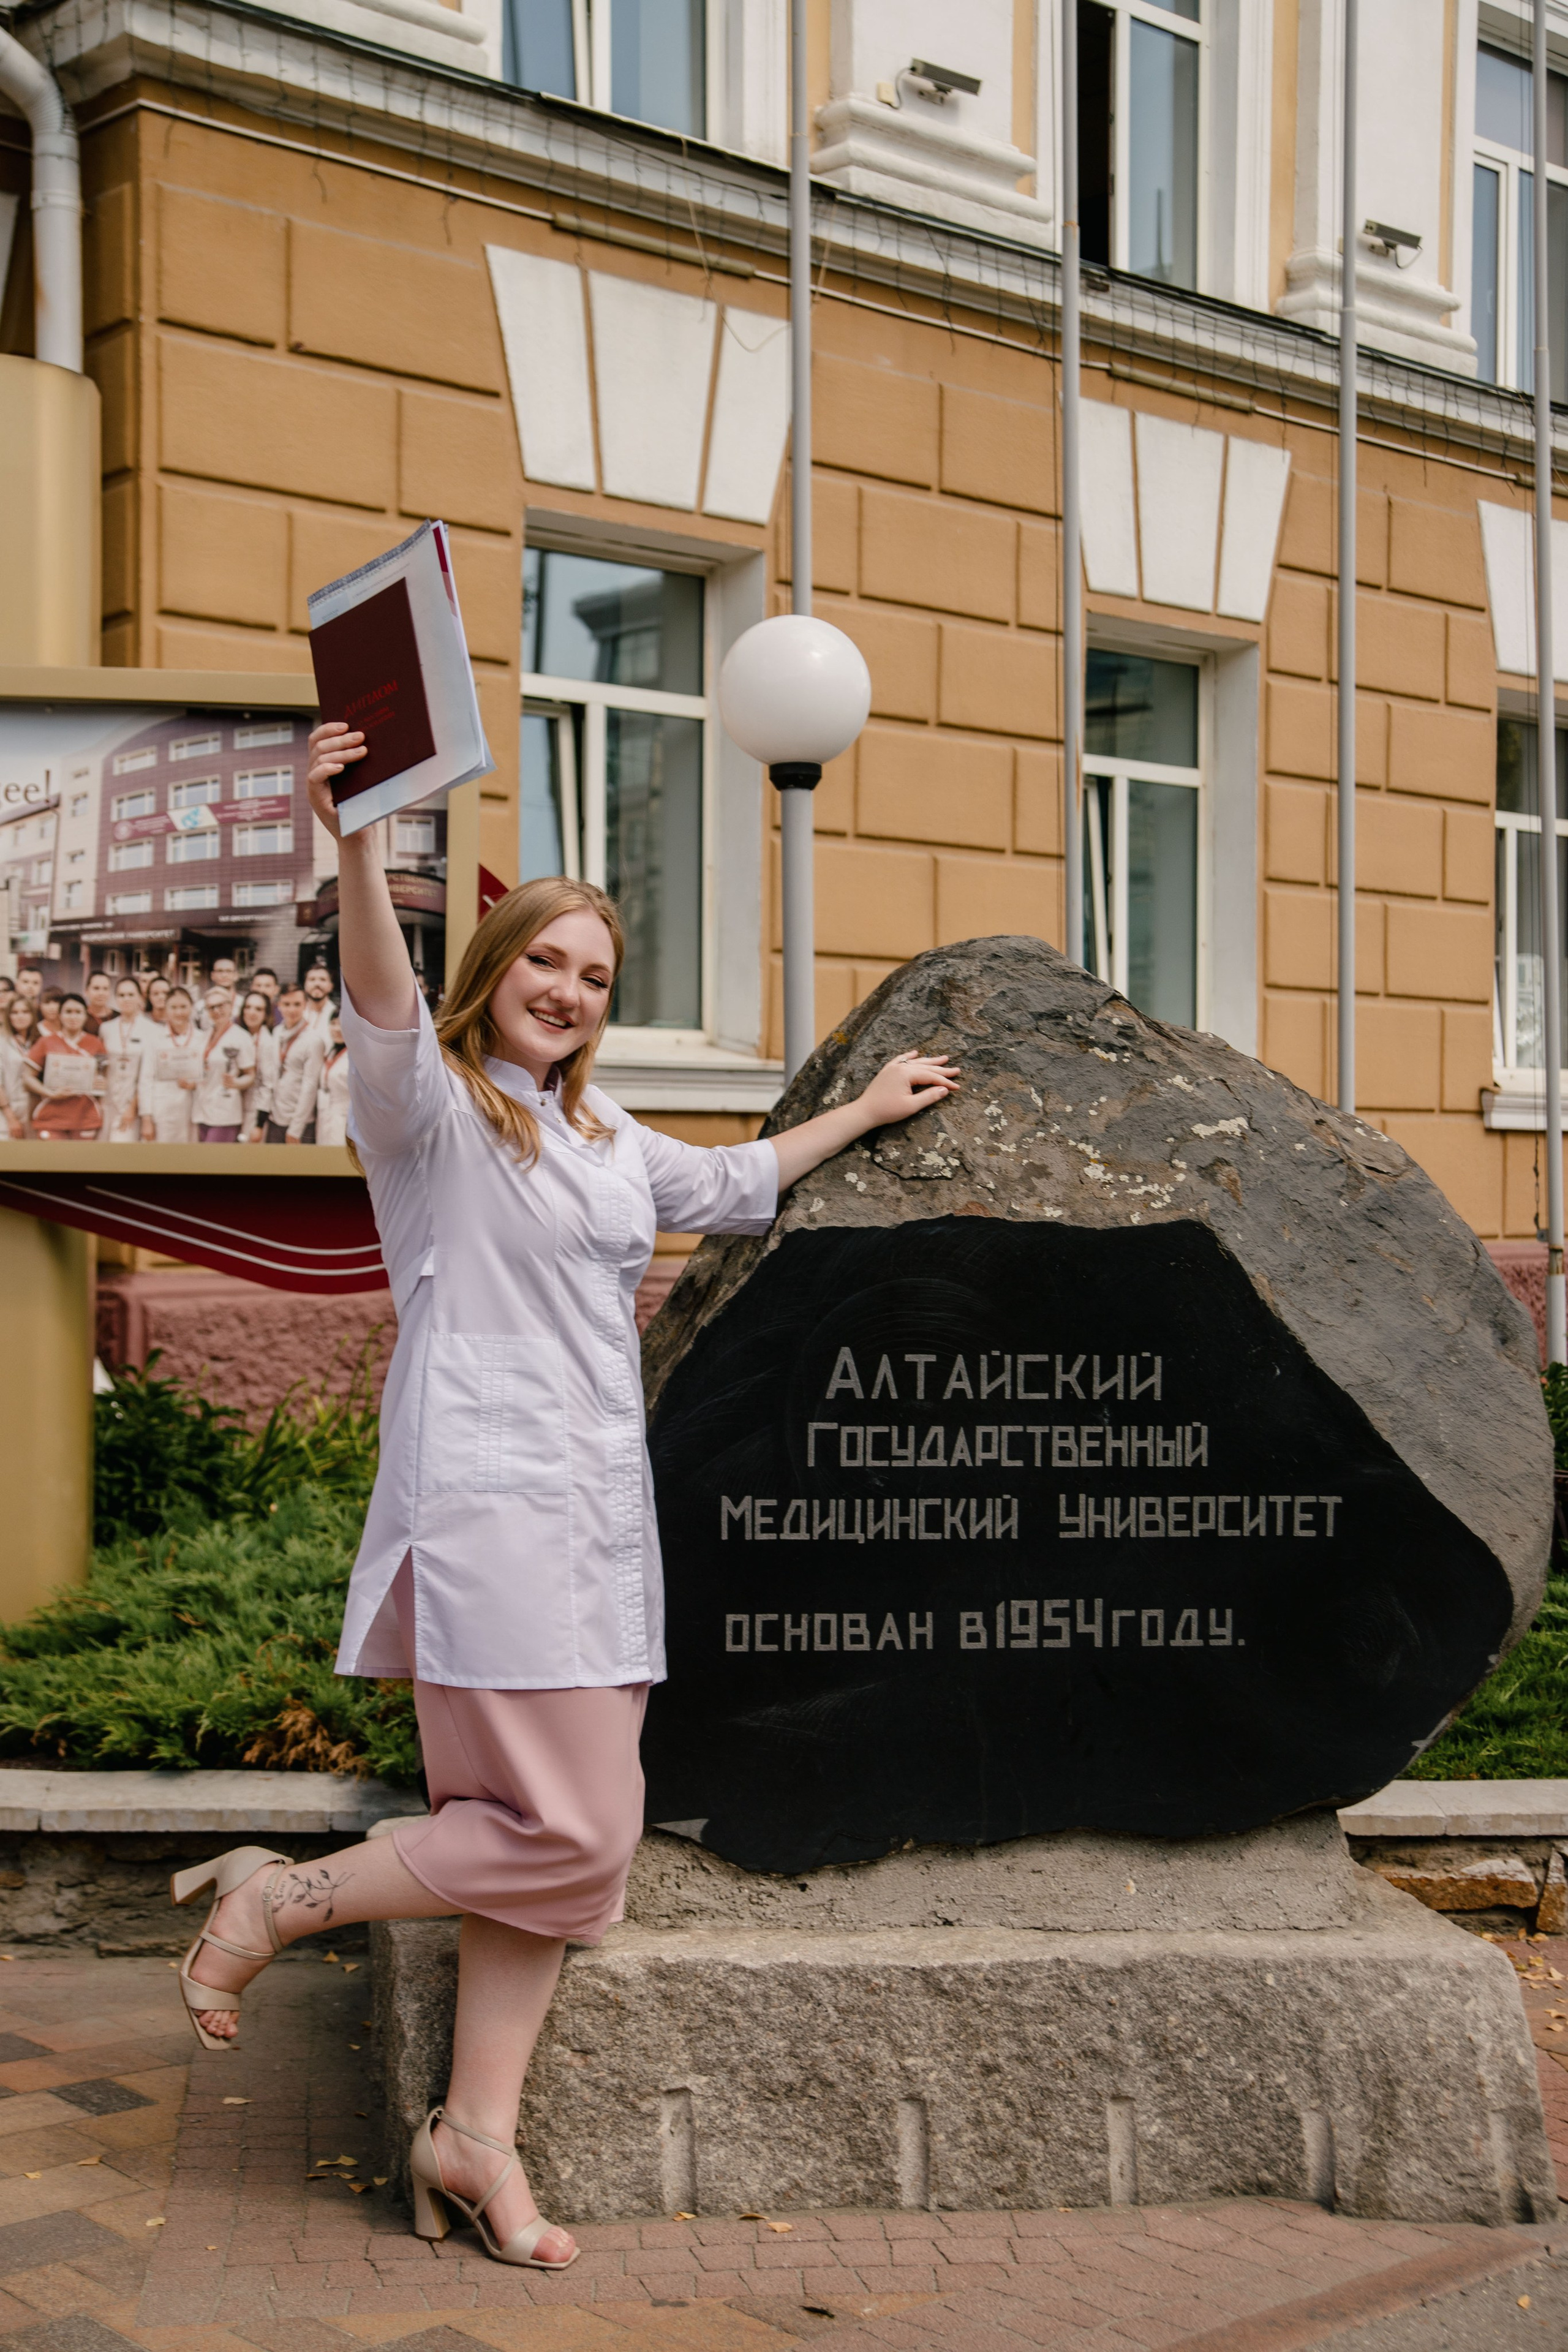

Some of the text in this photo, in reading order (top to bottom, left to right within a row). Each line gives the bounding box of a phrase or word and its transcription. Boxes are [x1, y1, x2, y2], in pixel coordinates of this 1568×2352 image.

[343, 679, 399, 721] ДИПЛОМ
[0, 769, 51, 804] ее!
[825, 1346, 1163, 1401] АЛТАЙСКИЙ
[807, 1422, 1208, 1468] ГОСУДАРСТВЕННЫЙ
[720, 1494, 1343, 1544] МЕДИЦИНСКИЙ УНИВЕРСИТЕТ
[725, 1611, 933, 1651] ОСНОВАН
